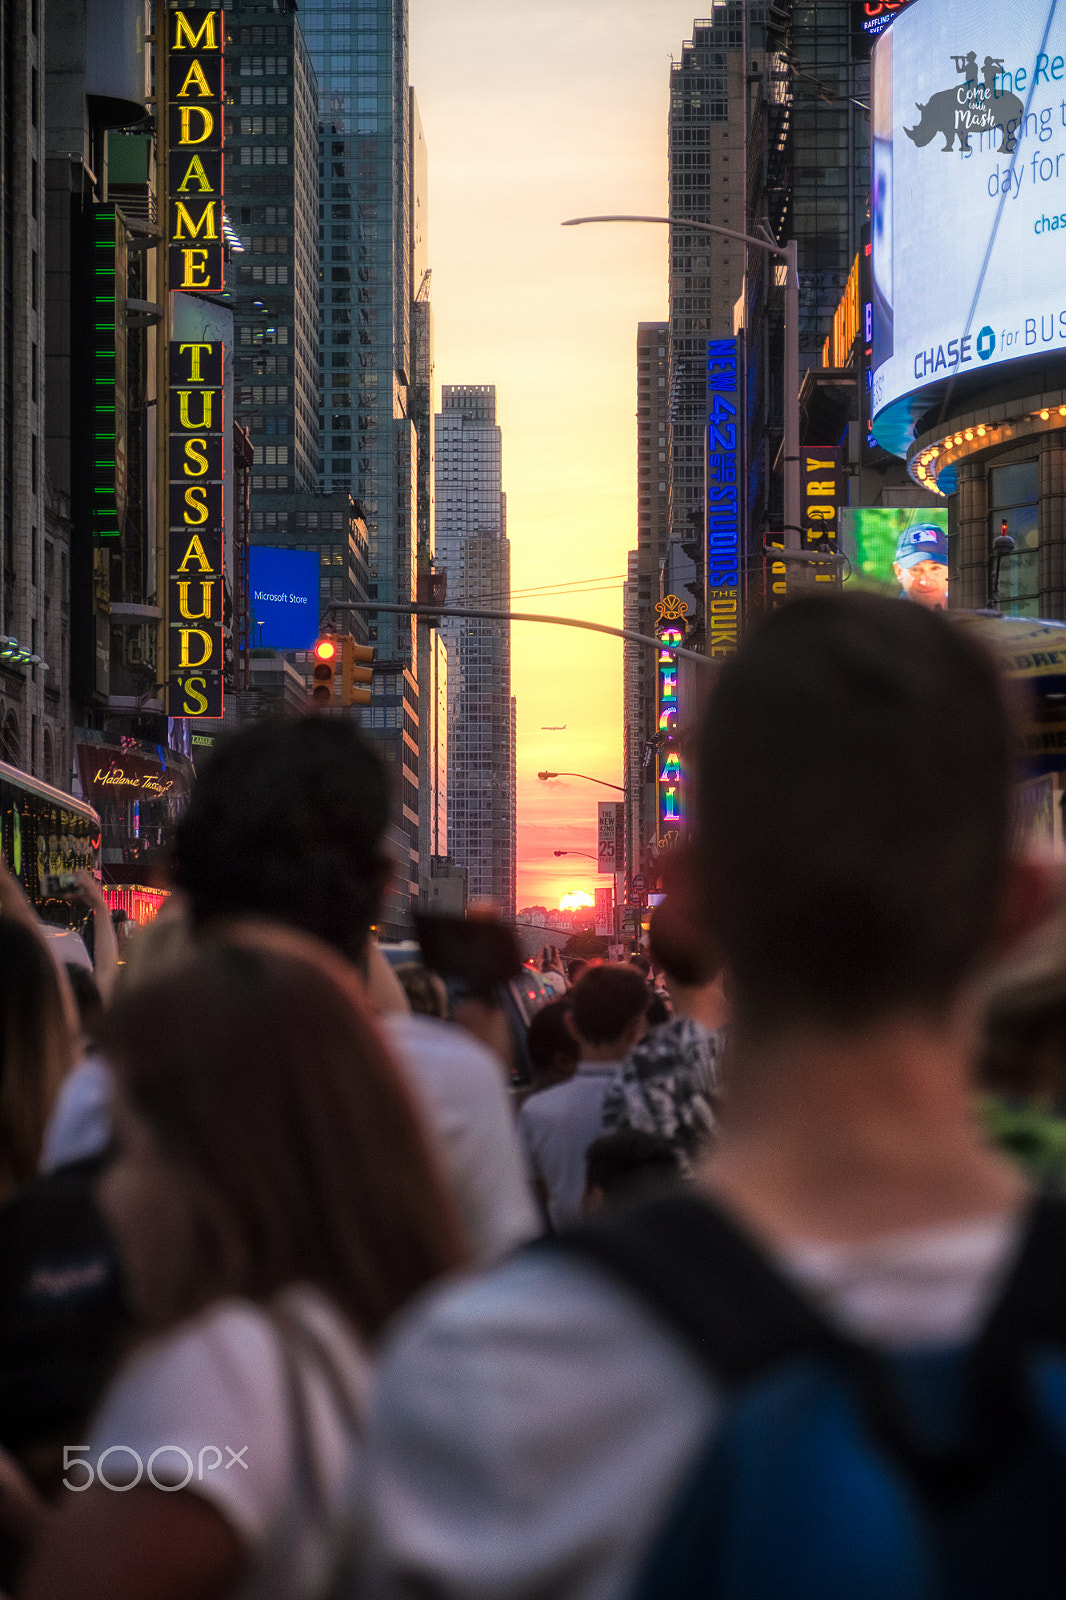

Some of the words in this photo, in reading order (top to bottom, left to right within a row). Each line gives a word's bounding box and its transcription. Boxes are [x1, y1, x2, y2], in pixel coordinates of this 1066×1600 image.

[993, 66, 1027, 100] the
[1035, 53, 1066, 86] Re
[172, 11, 219, 287] MADAME
[979, 106, 1053, 153] ringing
[988, 163, 1025, 200] day
[1030, 150, 1065, 184] for
[708, 339, 737, 392] NEW
[914, 335, 972, 379] CHASE
[1000, 329, 1020, 352] for
[708, 485, 737, 587] STUDIOS
[254, 590, 287, 602] Microsoft
[289, 594, 307, 604] Store
[710, 600, 737, 657] DUKE
[93, 768, 140, 787] Madame
[599, 817, 615, 826] NEW
[602, 810, 612, 818] THE
[599, 841, 615, 856] 25
[595, 913, 607, 925] 25
